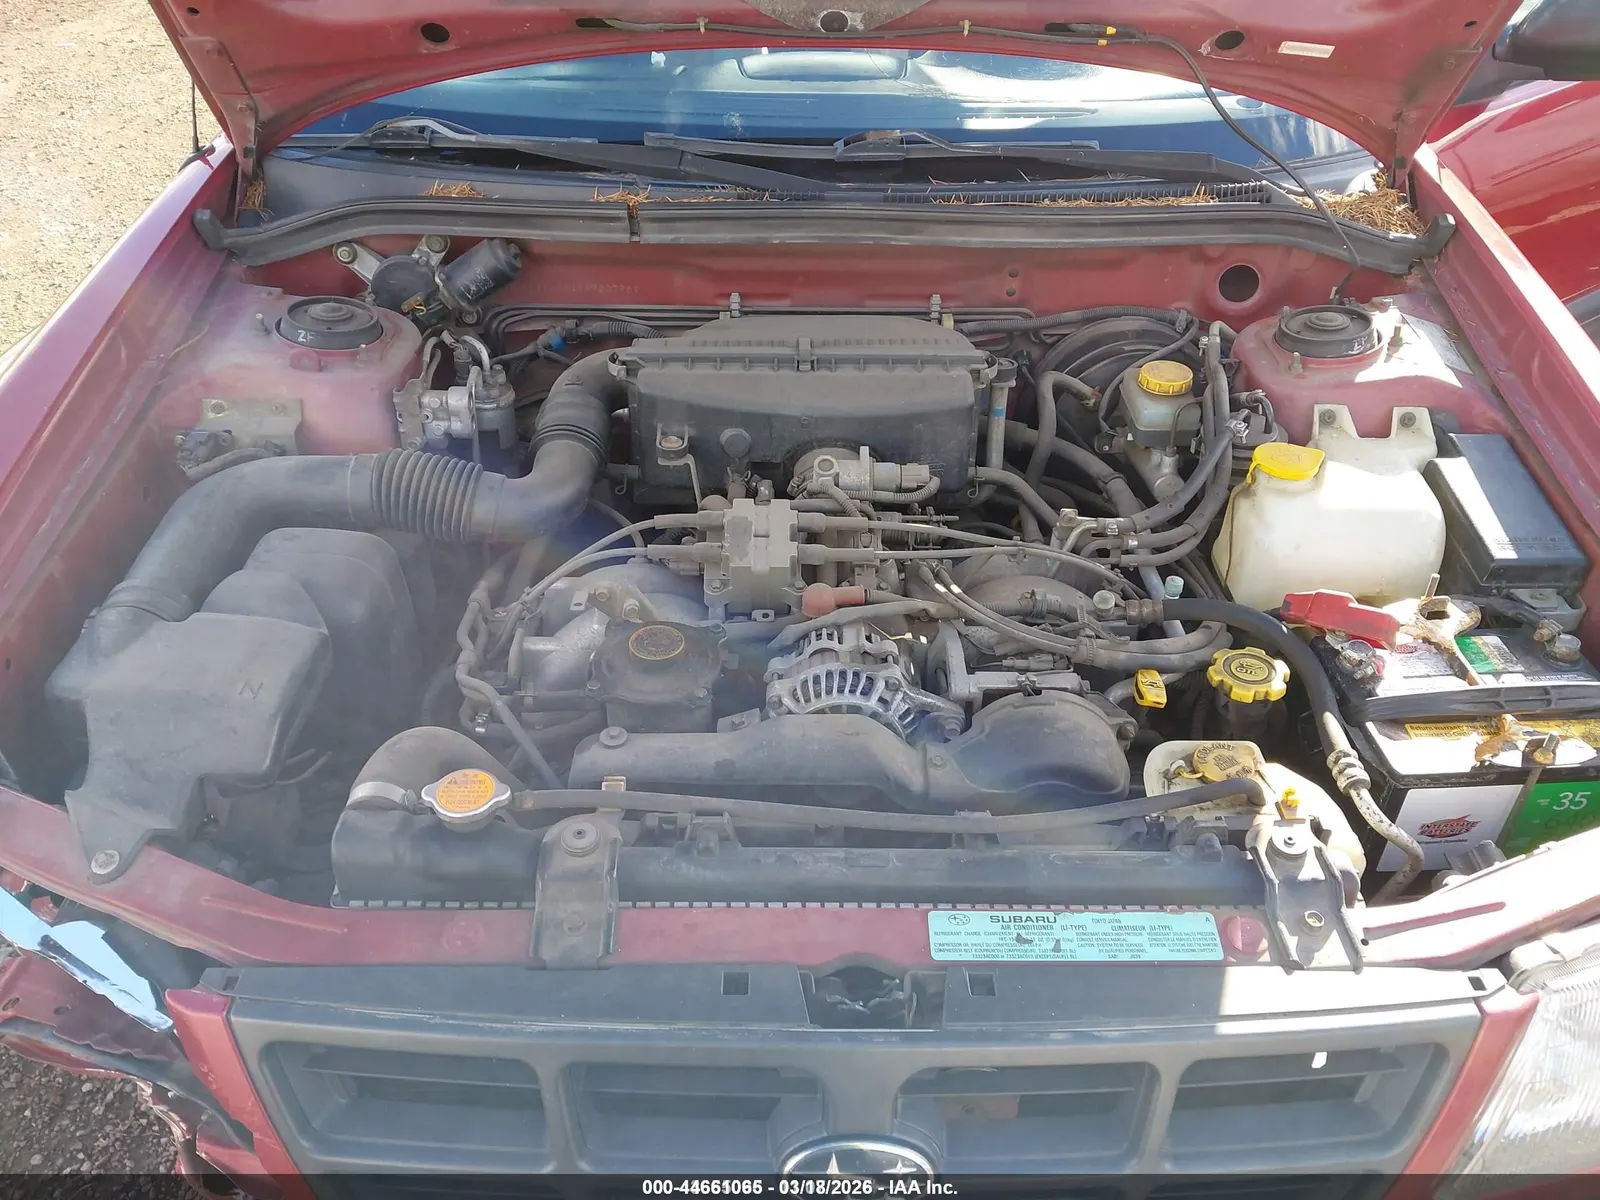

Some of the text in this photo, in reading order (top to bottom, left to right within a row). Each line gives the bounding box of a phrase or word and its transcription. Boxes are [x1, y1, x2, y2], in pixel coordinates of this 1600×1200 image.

[1236, 665, 1258, 677] OIL
[1552, 791, 1592, 811] 35
[1420, 821, 1477, 830] INTERSTATE
[990, 915, 1057, 923] SUBARU
